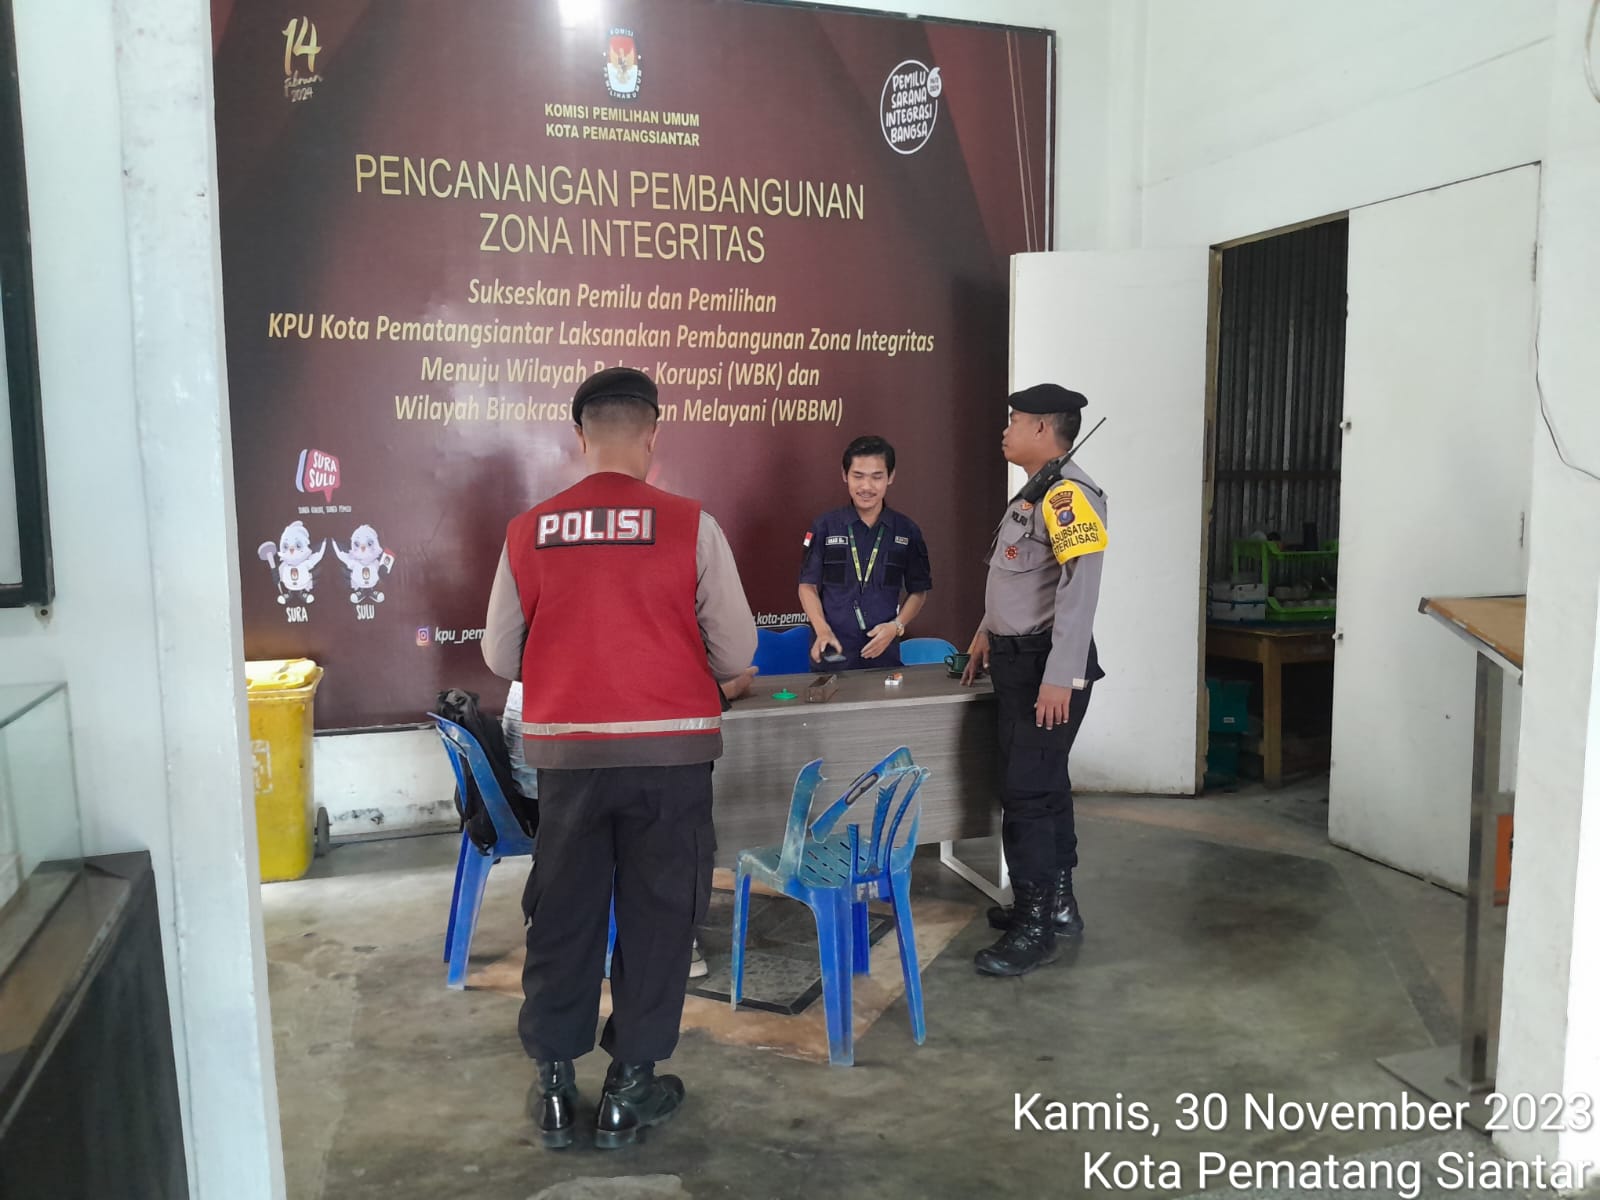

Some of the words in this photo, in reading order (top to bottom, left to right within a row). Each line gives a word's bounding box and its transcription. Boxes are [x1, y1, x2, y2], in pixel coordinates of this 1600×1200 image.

[282, 15, 322, 76] 14
[892, 70, 927, 92] PEMILU
[891, 86, 928, 109] SARANA
[544, 103, 590, 120] KOMISI
[592, 107, 660, 124] PEMILIHAN
[662, 111, 701, 127] UMUM
[885, 103, 933, 127] INTEGRASI
[545, 123, 580, 139] KOTA
[582, 126, 701, 147] PEMATANGSIANTAR
[890, 120, 928, 144] BANGSA
[355, 153, 620, 208] PENCANANGAN
[629, 170, 866, 220] PEMBANGUNAN
[479, 212, 574, 256] ZONA
[582, 219, 766, 264] INTEGRITAS
[467, 278, 571, 307] Sukseskan
[577, 283, 642, 309] Pemilu
[647, 285, 682, 311] dan
[687, 287, 777, 313] Pemilihan
[268, 312, 314, 339] KPU
[320, 313, 370, 340] Kota
[376, 315, 554, 348] Pematangsiantar
[558, 321, 671, 348] Laksanakan
[676, 324, 805, 355] Pembangunan
[809, 327, 851, 351] Zona
[855, 328, 934, 357] Integritas
[420, 356, 500, 388] Menuju
[506, 358, 587, 388] Wilayah
[655, 361, 723, 390] Korupsi
[727, 362, 783, 391] (WBK)
[787, 363, 820, 386] dan
[394, 395, 479, 426] Wilayah
[486, 396, 574, 421] Birokrasi
[657, 403, 678, 422] an
[682, 398, 767, 427] Melayani
[770, 397, 843, 427] (WBBM)
[313, 451, 338, 473] SURA
[308, 469, 336, 488] SULU
[537, 508, 653, 545] POLISI
[286, 606, 309, 623] SURA
[356, 604, 375, 620] SULU
[434, 626, 486, 645] kpu_pem
